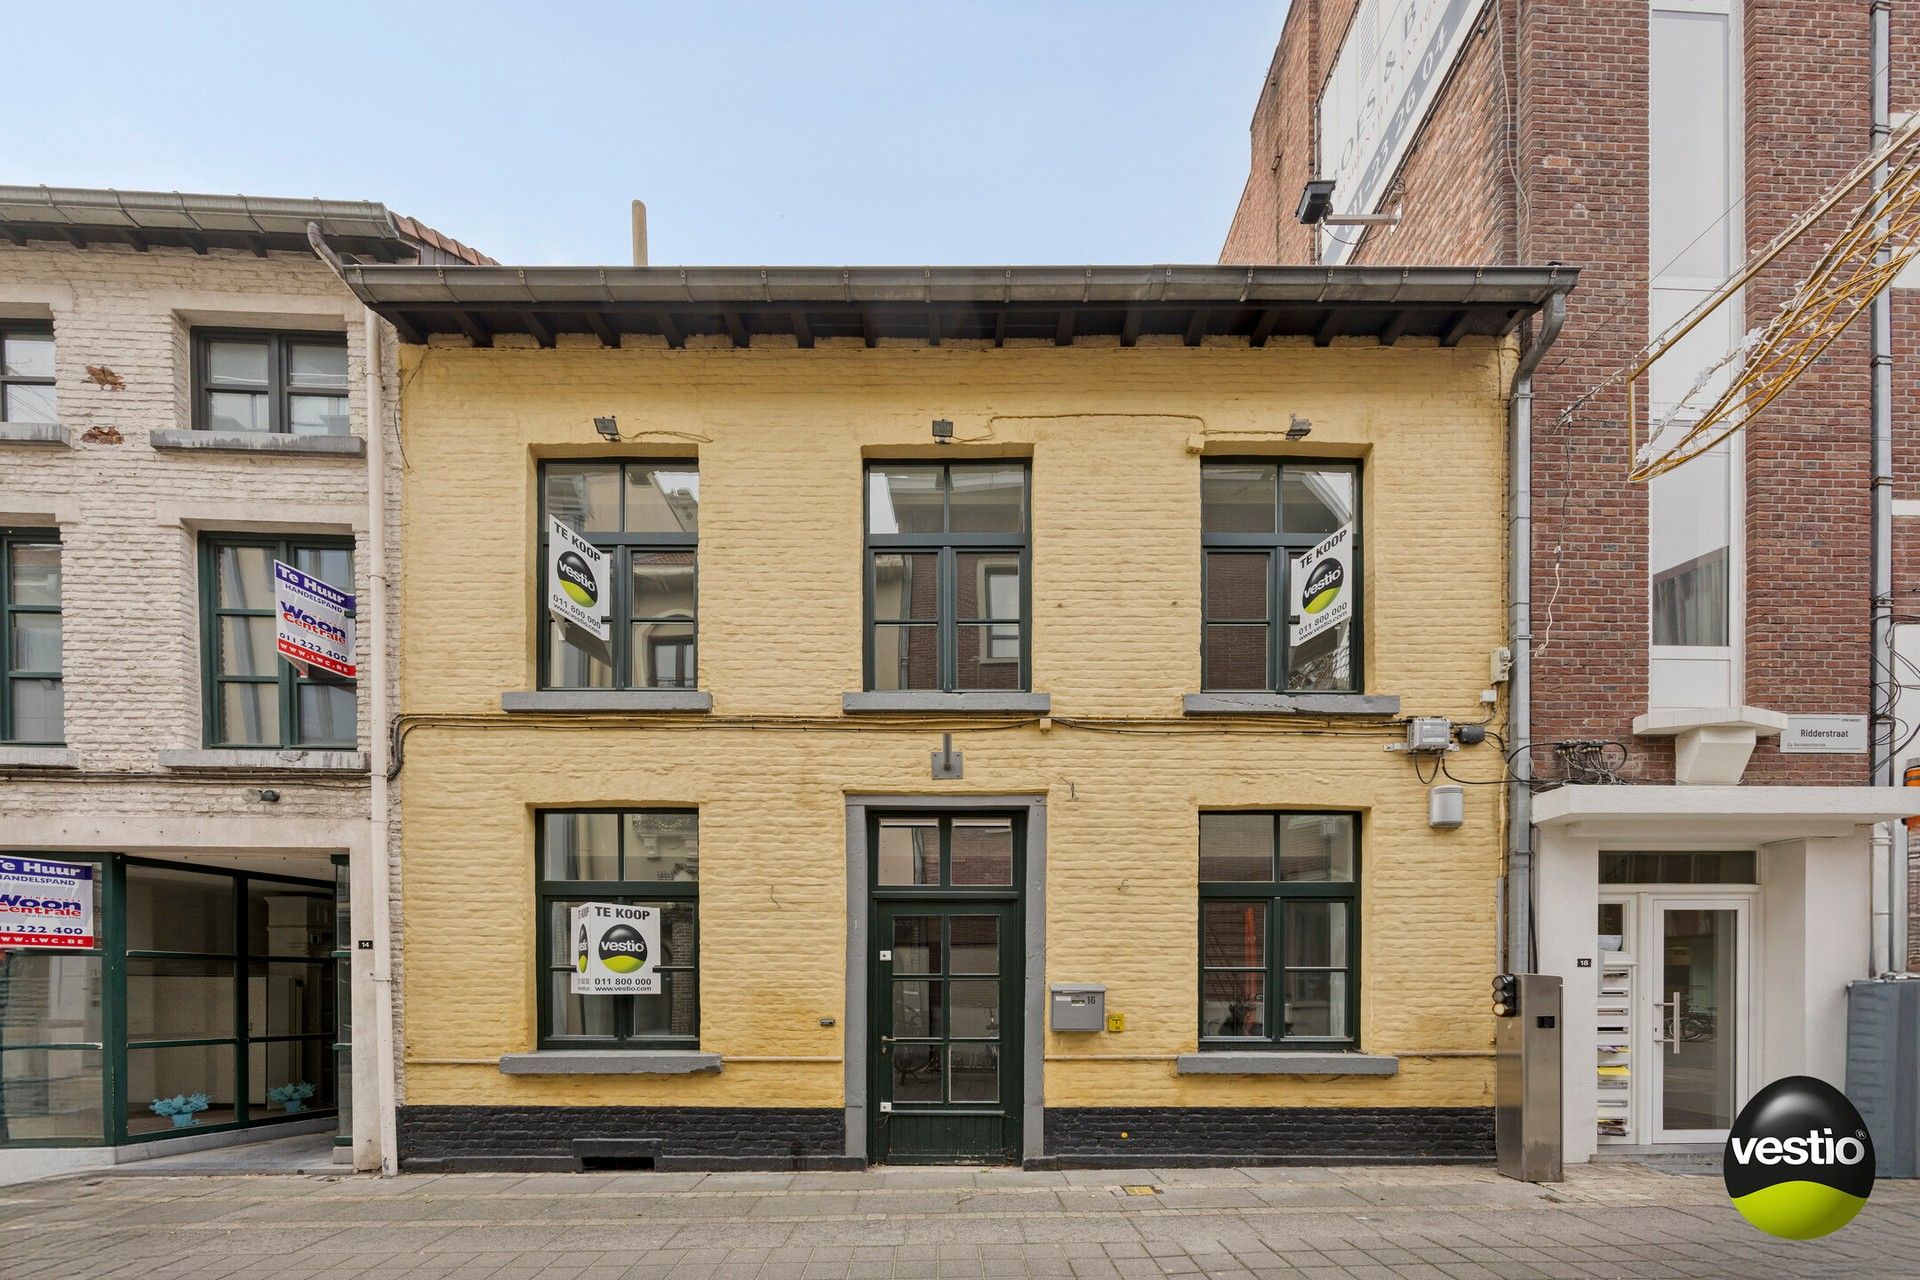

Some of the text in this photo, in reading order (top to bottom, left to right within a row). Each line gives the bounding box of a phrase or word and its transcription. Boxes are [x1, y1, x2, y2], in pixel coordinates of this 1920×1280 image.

[1395, 86, 1416, 138] 26
[1422, 25, 1447, 81] 04
[554, 521, 601, 562] TE KOOP
[1300, 529, 1348, 569] TE KOOP
[277, 565, 346, 603] Te Huur
[559, 560, 596, 592] vestio
[1303, 570, 1341, 599] vestio
[285, 583, 343, 614] HANDELSPAND
[553, 594, 601, 630] 011 800 000
[280, 600, 347, 639] Woon
[283, 612, 347, 645] Centrale
[1298, 601, 1348, 636] 011 800 000
[1298, 610, 1348, 641] www.vestio.com
[279, 632, 348, 663] 011 222 400
[1800, 729, 1849, 738] Ridderstraat
[0, 859, 81, 876] e Huur
[594, 906, 611, 918] TE
[615, 908, 651, 920] KOOP
[16, 924, 47, 934] 222
[53, 927, 83, 935] 400
[601, 940, 645, 952] vestio
[594, 978, 612, 986] 011
[614, 978, 632, 986] 800
[635, 978, 652, 986] 000
[1087, 995, 1096, 1005] 16
